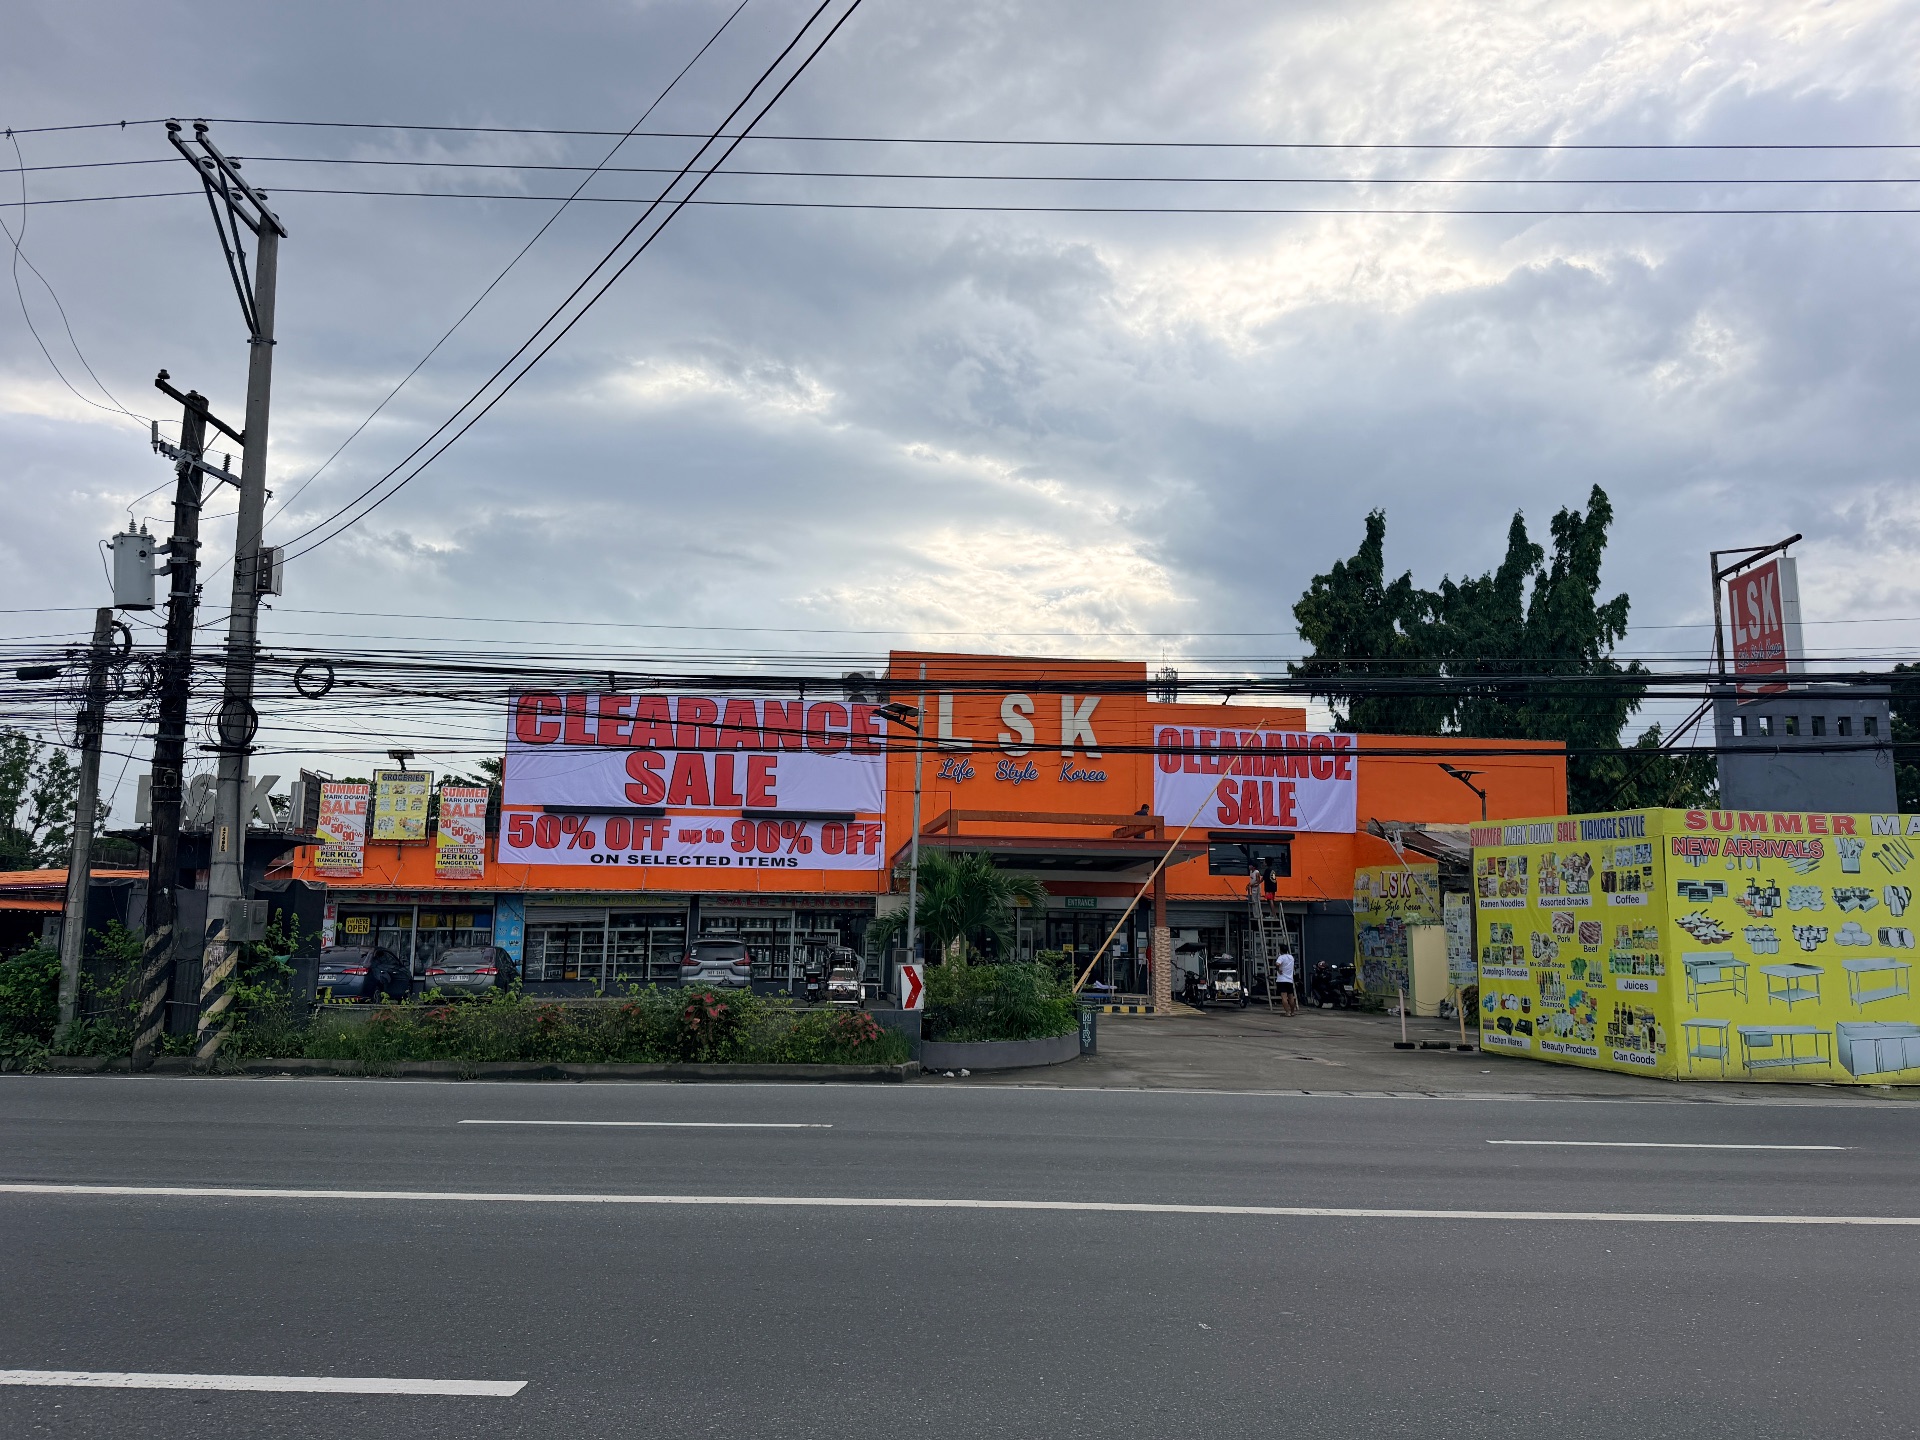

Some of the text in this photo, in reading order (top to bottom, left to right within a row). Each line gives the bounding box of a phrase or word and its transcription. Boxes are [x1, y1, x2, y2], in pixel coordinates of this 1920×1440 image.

[1732, 572, 1779, 646] LSK
[514, 691, 882, 756] CLEARANCE
[1158, 728, 1352, 780] CLEARANCE
[382, 773, 426, 782] GROCERIES
[937, 758, 1108, 785] Life Style Korea
[624, 751, 778, 807] SALE
[322, 784, 369, 795] SUMMER
[442, 788, 487, 798] SUMMER
[320, 799, 367, 816] SALE
[1216, 779, 1298, 827] SALE
[440, 803, 486, 818] SALE
[320, 815, 340, 826] 30%
[440, 818, 459, 828] 30%
[1683, 809, 1858, 835] SUMMER
[331, 823, 352, 834] 50%
[452, 826, 472, 837] 50%
[507, 813, 882, 856] 50% OFF up to 90% OFF
[1470, 815, 1646, 847] SUMMER MARK DOWN SALE TIANGGE STYLE
[342, 830, 364, 842] 90%
[463, 833, 484, 844] 90%
[1671, 837, 1824, 859] NEW ARRIVALS
[590, 853, 799, 868] ON SELECTED ITEMS
[1380, 870, 1413, 898] LSK
[357, 891, 471, 904] SUMMER
[552, 895, 662, 905] MARKDOWN
[716, 896, 869, 909] SALE TIANGGE
[1067, 898, 1095, 907] ENTRANCE
[1480, 899, 1525, 908] Ramen Noodles
[1540, 896, 1589, 907] Assorted Snacks
[1615, 895, 1640, 905] Coffee
[1384, 899, 1400, 917] Style
[1404, 898, 1421, 911] Korea
[347, 924, 368, 932] OPEN
[1557, 935, 1571, 943] Pork
[1583, 945, 1598, 953] Beef
[1623, 981, 1649, 991] Juices
[1541, 1040, 1597, 1056] Beauty Products
[1613, 1051, 1656, 1065] Can Goods
